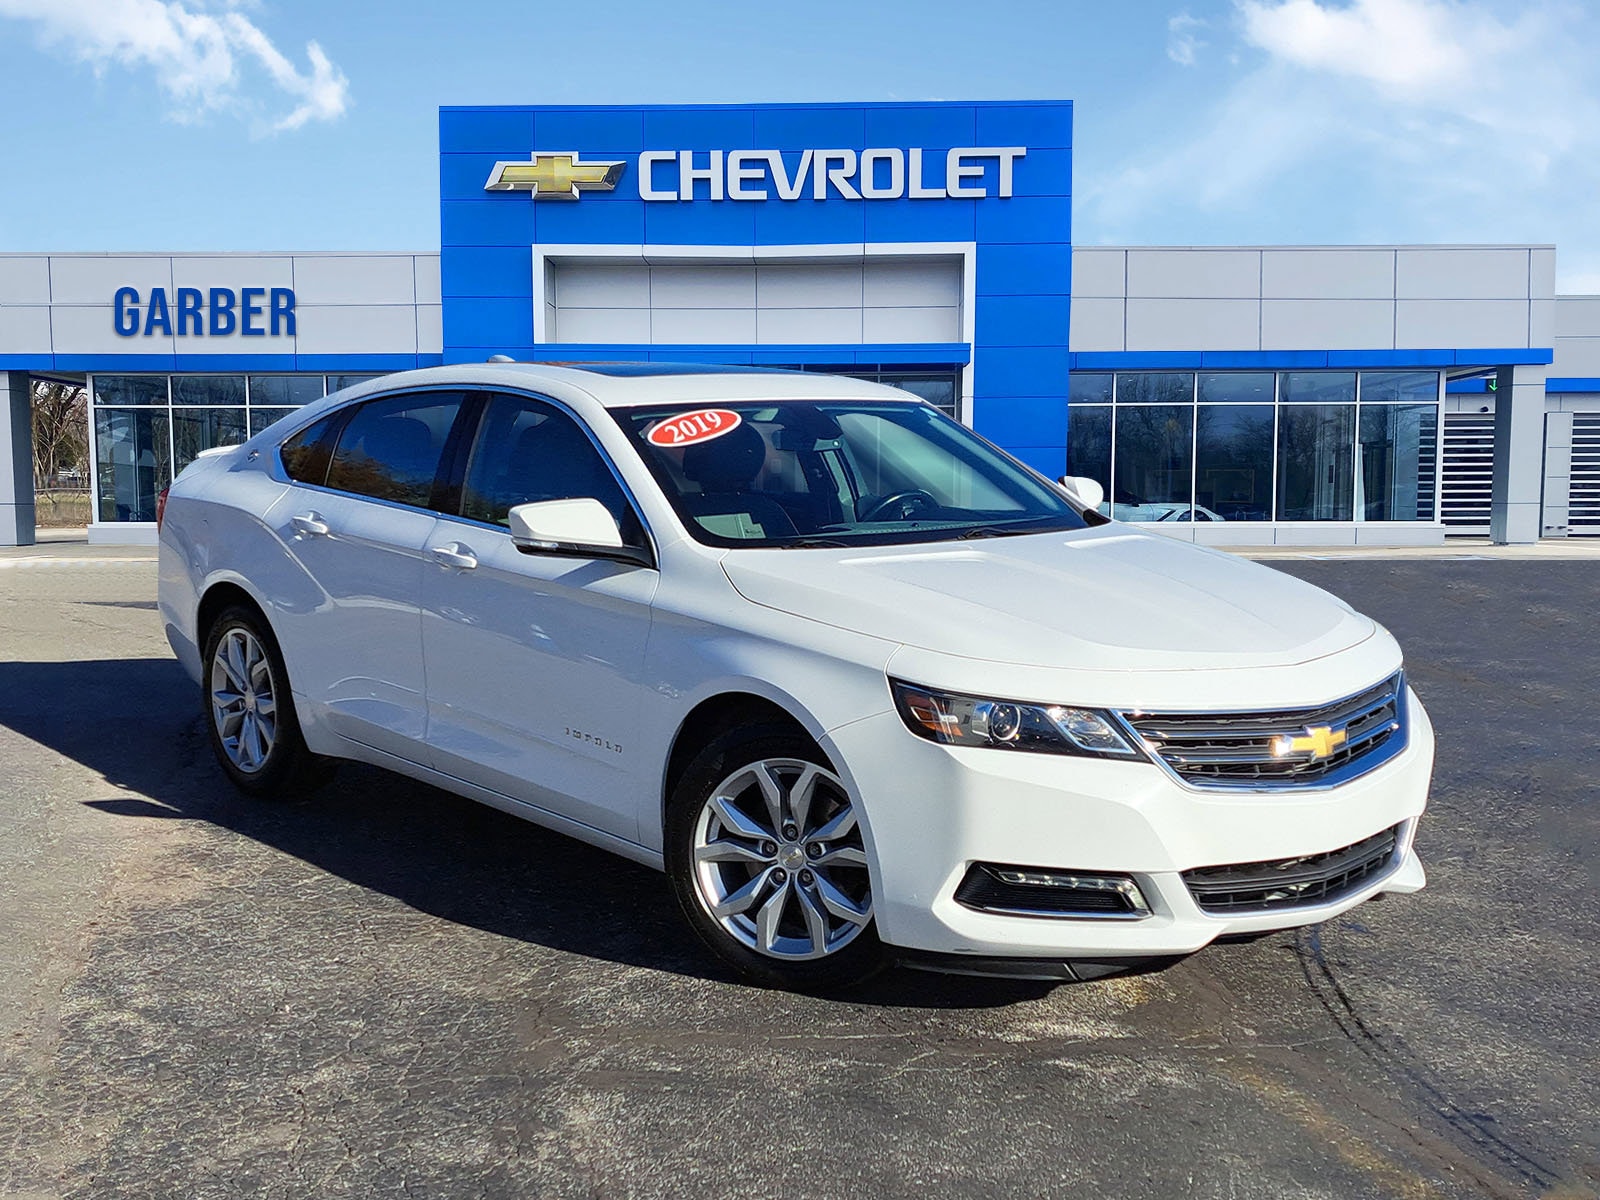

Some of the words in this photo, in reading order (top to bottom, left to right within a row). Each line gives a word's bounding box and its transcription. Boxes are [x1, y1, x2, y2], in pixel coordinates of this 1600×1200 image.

[638, 146, 1026, 201] CHEVROLET
[114, 286, 297, 336] GARBER
[664, 410, 722, 443] 2019
